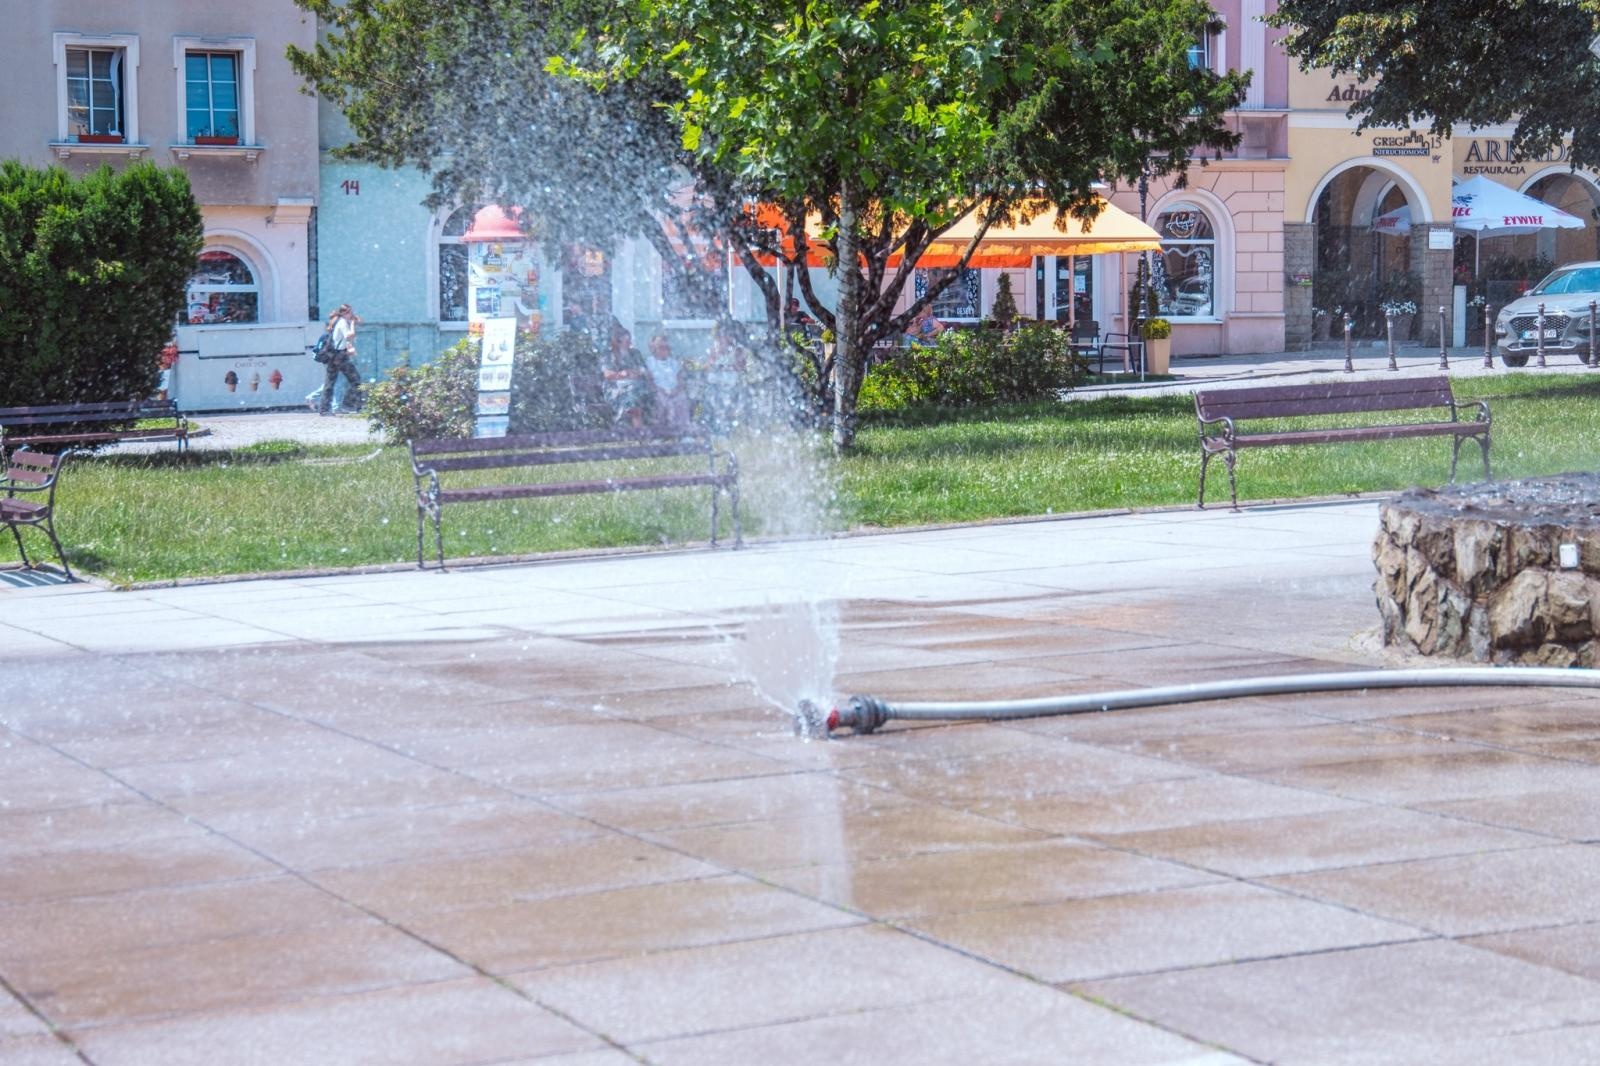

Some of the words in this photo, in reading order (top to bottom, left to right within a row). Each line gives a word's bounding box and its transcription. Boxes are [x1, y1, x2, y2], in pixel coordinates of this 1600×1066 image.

[1326, 84, 1372, 102] Adw
[1463, 166, 1526, 175] RESTAURACJA
[340, 180, 359, 196] 14
[1452, 207, 1472, 217] IEC
